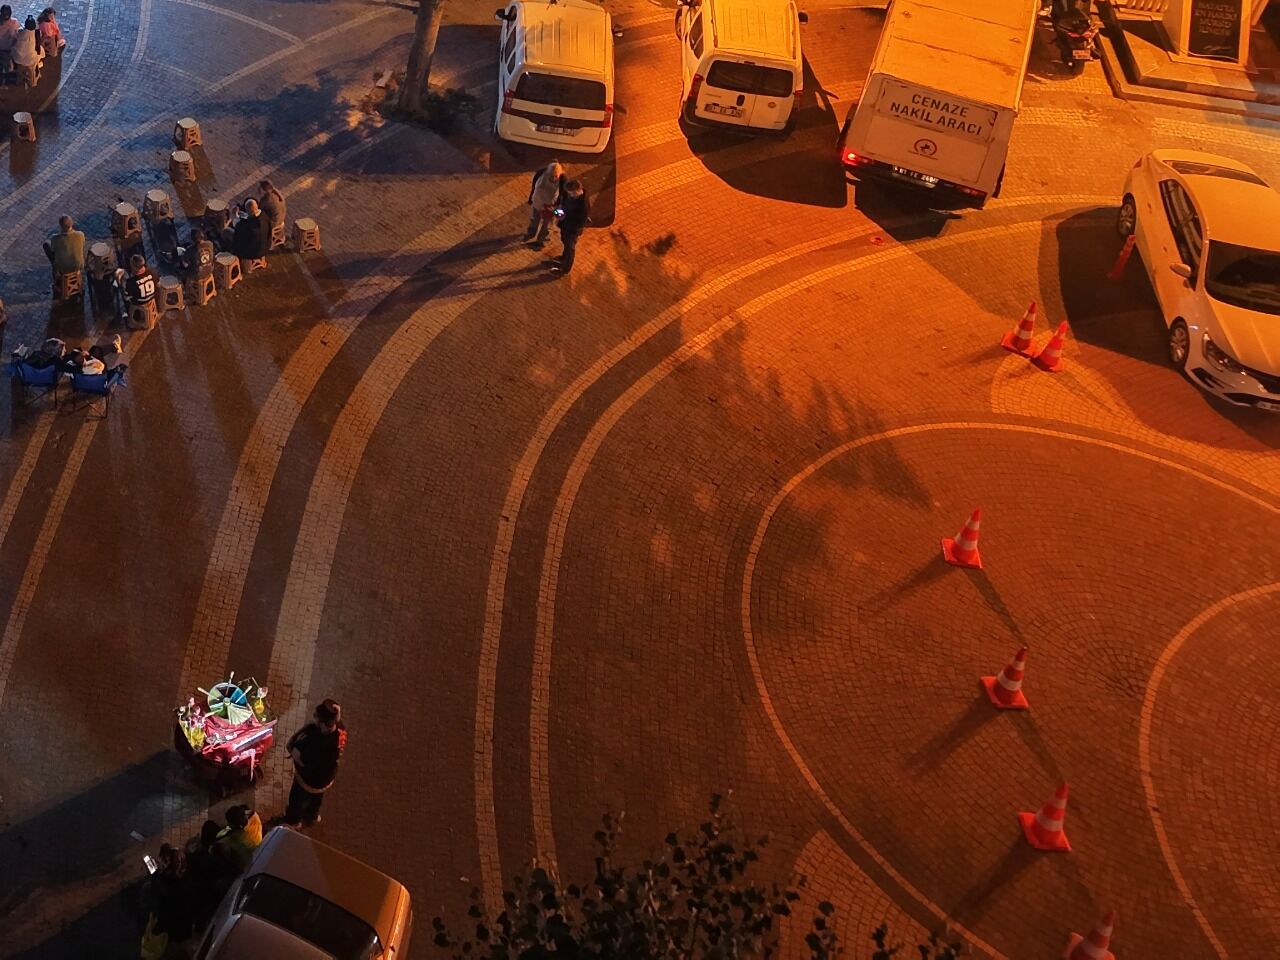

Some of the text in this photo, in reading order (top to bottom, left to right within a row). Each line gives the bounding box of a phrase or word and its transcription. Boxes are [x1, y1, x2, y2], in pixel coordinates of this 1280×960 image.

[911, 93, 969, 118] CENAZE
[936, 116, 982, 136] ARACI
[138, 280, 155, 297] 19
